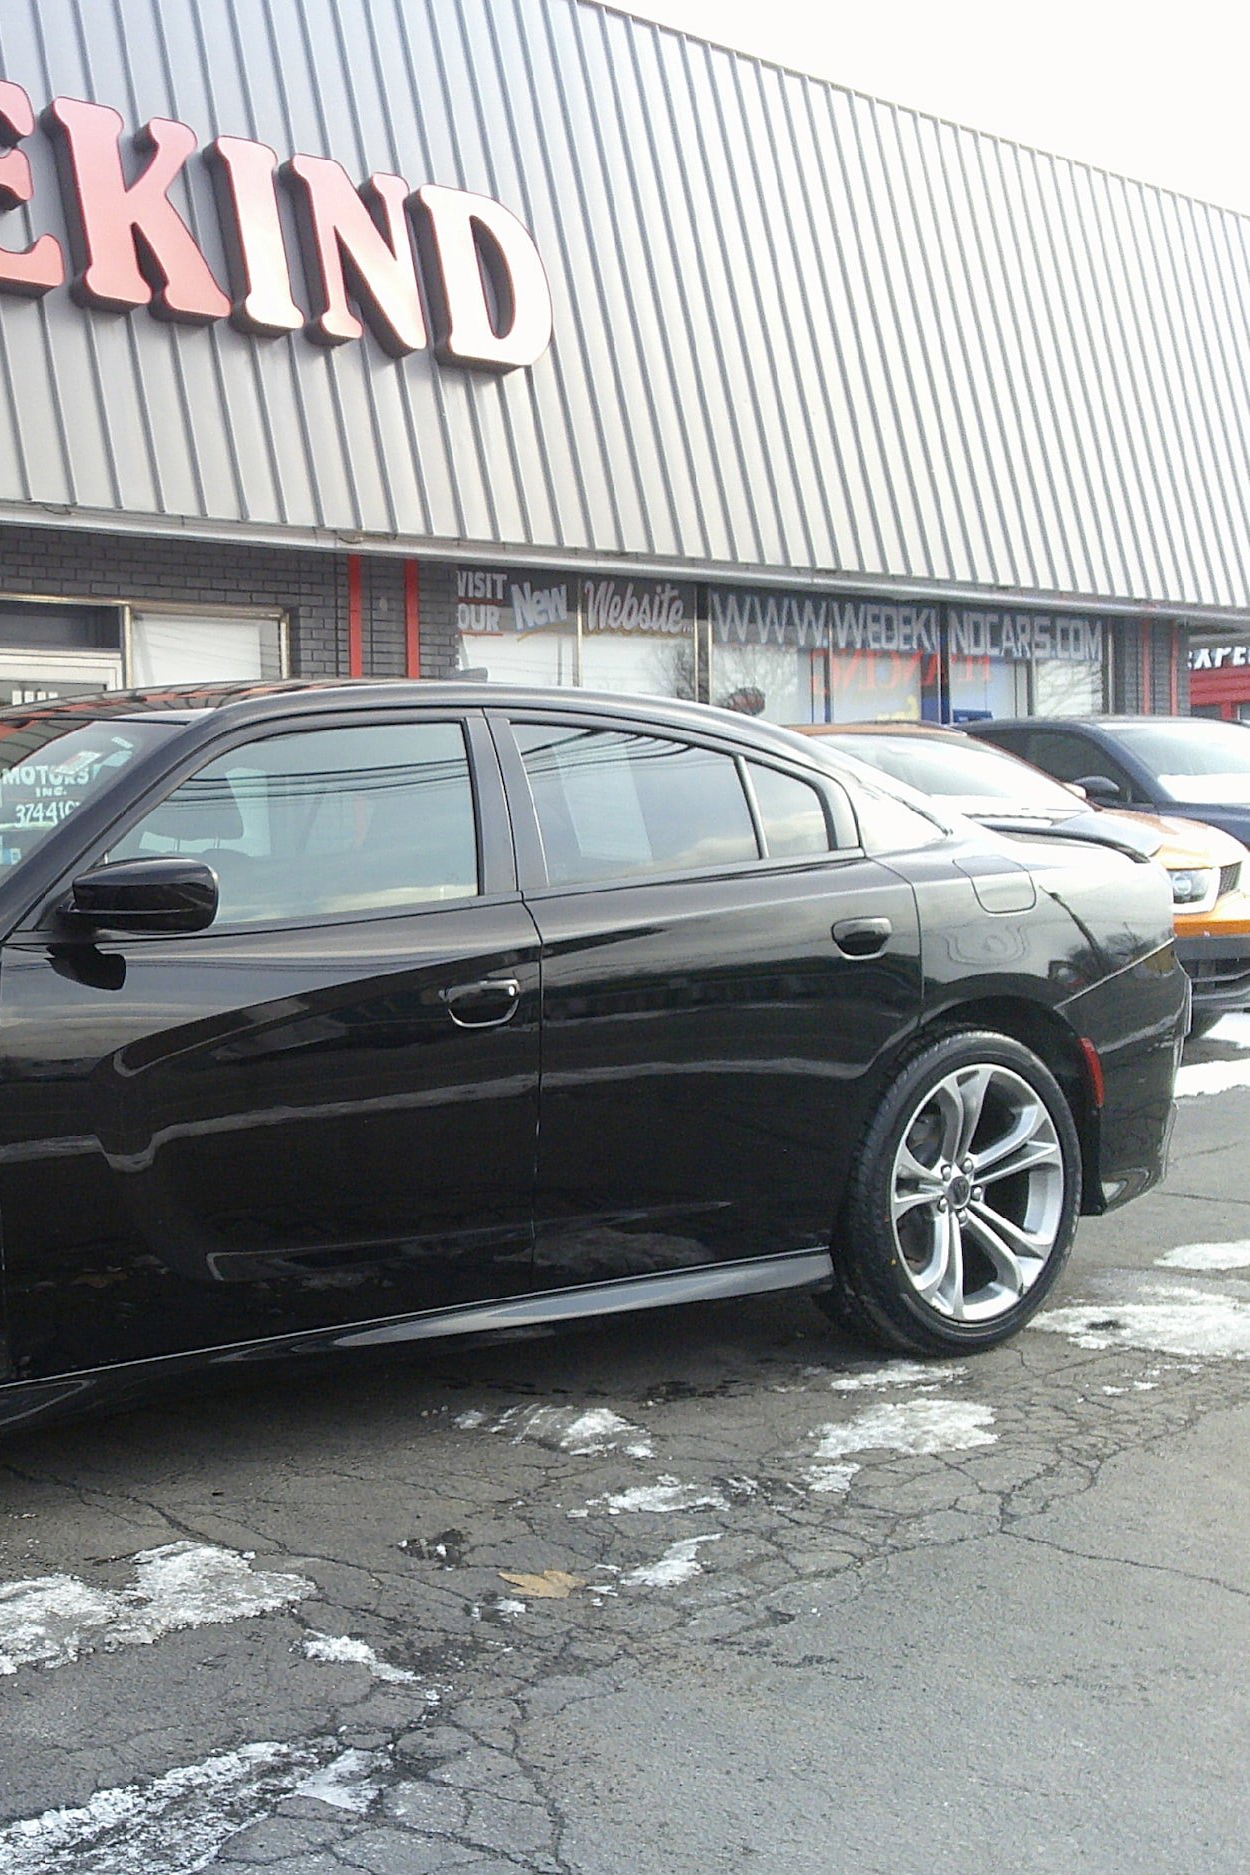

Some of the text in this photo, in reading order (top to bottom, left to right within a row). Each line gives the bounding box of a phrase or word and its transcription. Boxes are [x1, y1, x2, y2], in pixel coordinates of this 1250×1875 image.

[456, 570, 507, 600] VISIT
[457, 602, 500, 632] OUR
[510, 582, 567, 632] New
